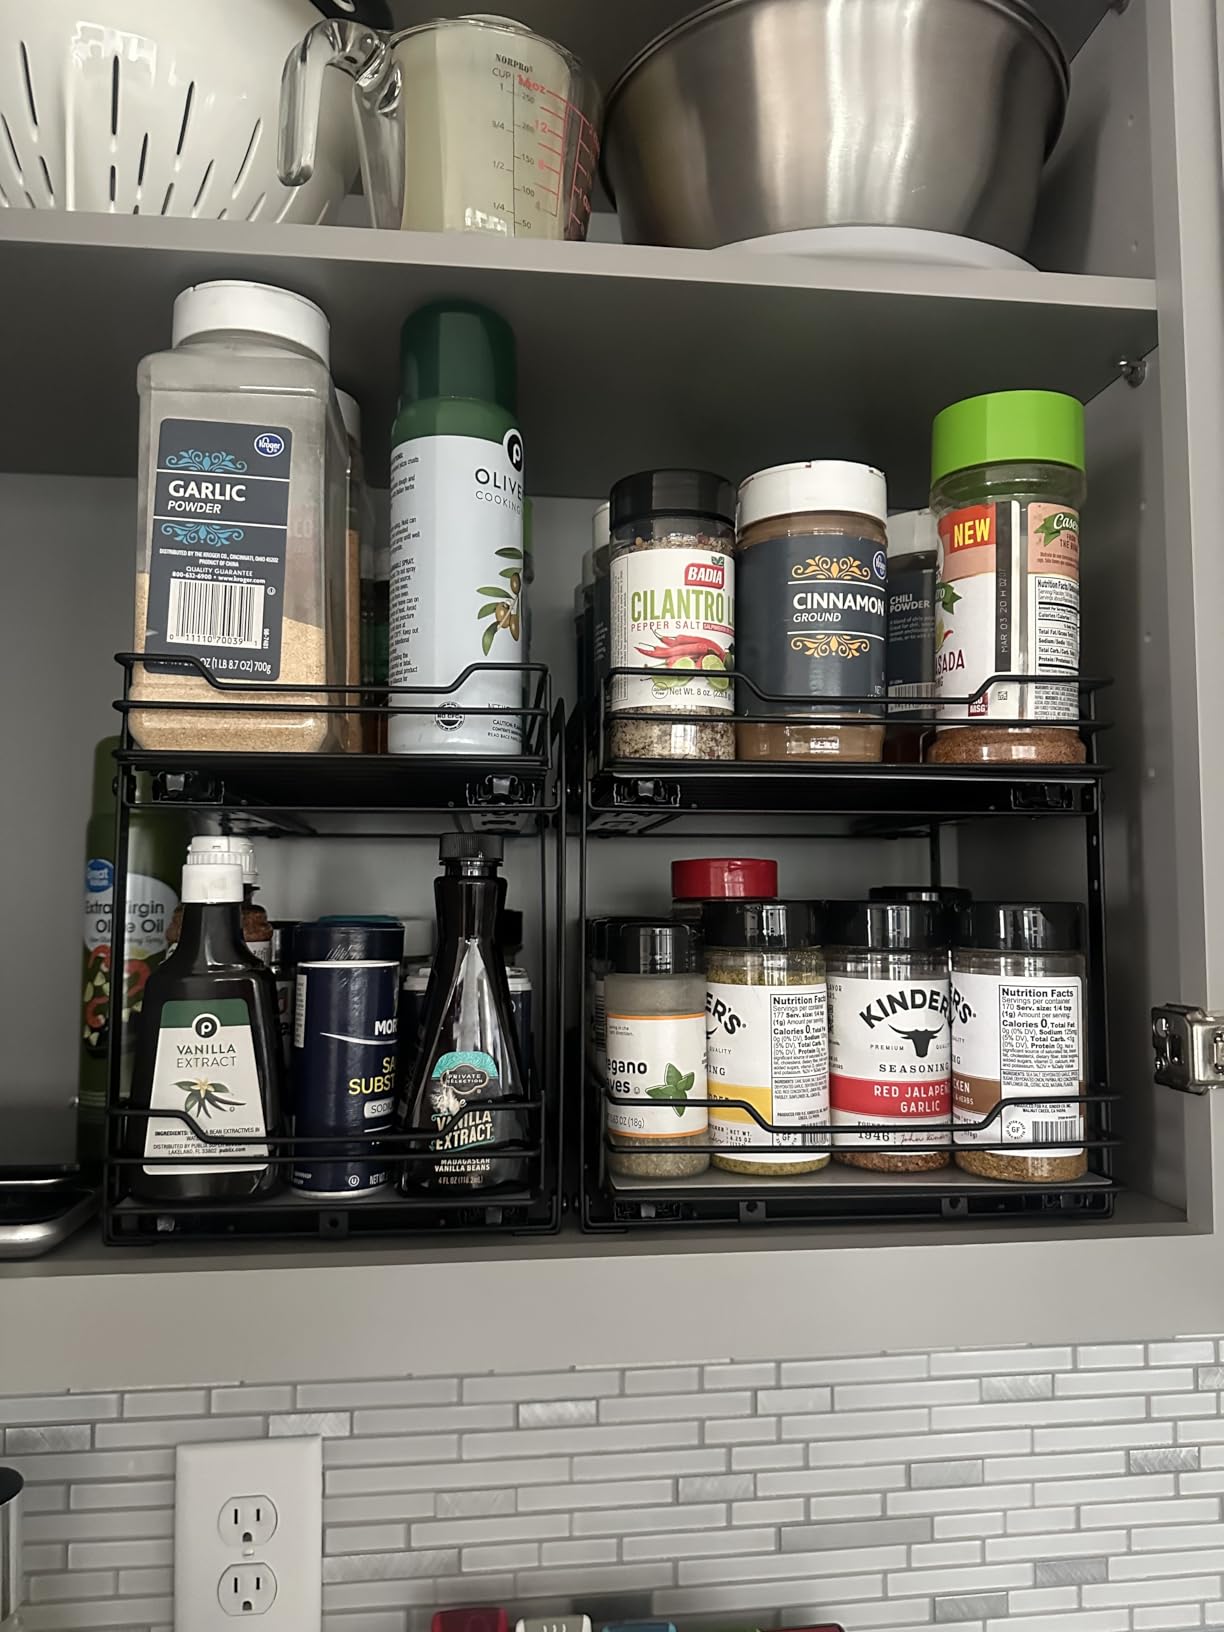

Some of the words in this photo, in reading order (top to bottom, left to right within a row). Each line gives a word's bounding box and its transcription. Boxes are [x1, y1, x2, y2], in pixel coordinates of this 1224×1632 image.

[495, 53, 530, 73] NORPRO
[492, 68, 511, 80] CUP
[492, 160, 505, 169] 1/2
[521, 153, 535, 165] 150
[521, 186, 535, 197] 100
[492, 202, 505, 211] 1/4
[521, 220, 532, 229] 50
[258, 436, 281, 453] Kroger
[168, 480, 246, 501] GARLIC
[167, 500, 222, 514] POWDER
[953, 517, 991, 548] NEW
[214, 568, 253, 577] GUARANTEE
[687, 566, 722, 584] BADIA
[218, 575, 266, 584] www.kroger.com
[792, 592, 885, 616] CINNAMON
[889, 593, 913, 605] CHILI
[631, 589, 724, 624] CILANTRO
[889, 599, 931, 613] POWDER
[999, 600, 1008, 613] 20
[792, 612, 841, 622] GROUND
[630, 621, 669, 632] PEPPER
[675, 620, 700, 630] SALT
[215, 636, 243, 645] 70039
[1000, 634, 1008, 653] MAR
[218, 659, 227, 669] LB
[228, 660, 238, 669] 8.7
[239, 660, 253, 672] OZ)
[254, 661, 272, 675] 700g
[669, 687, 682, 696] Net
[683, 688, 695, 696] Wt.
[696, 688, 702, 696] 8
[702, 689, 712, 697] oz.
[969, 704, 986, 713] MSG
[127, 900, 165, 918] irgin
[141, 918, 164, 933] Oil
[1001, 988, 1048, 997] Nutrition
[1050, 989, 1074, 998] Facts
[773, 996, 813, 1004] Nutrition
[1001, 996, 1031, 1005] Servings
[773, 1005, 798, 1013] Servings
[1001, 1010, 1016, 1018] (1g)
[1002, 1019, 1039, 1028] Calories
[176, 1044, 237, 1055] VANILLA
[176, 1056, 237, 1069] EXTRACT
[879, 1062, 949, 1073] SEASONING
[873, 1085, 899, 1097] RED
[900, 1100, 941, 1113] GARLIC
[619, 1115, 627, 1126] OZ
[627, 1116, 645, 1129] (18g)
[435, 1123, 493, 1151] EXTRACT
[442, 1176, 449, 1185] FL
[449, 1176, 457, 1184] OZ
